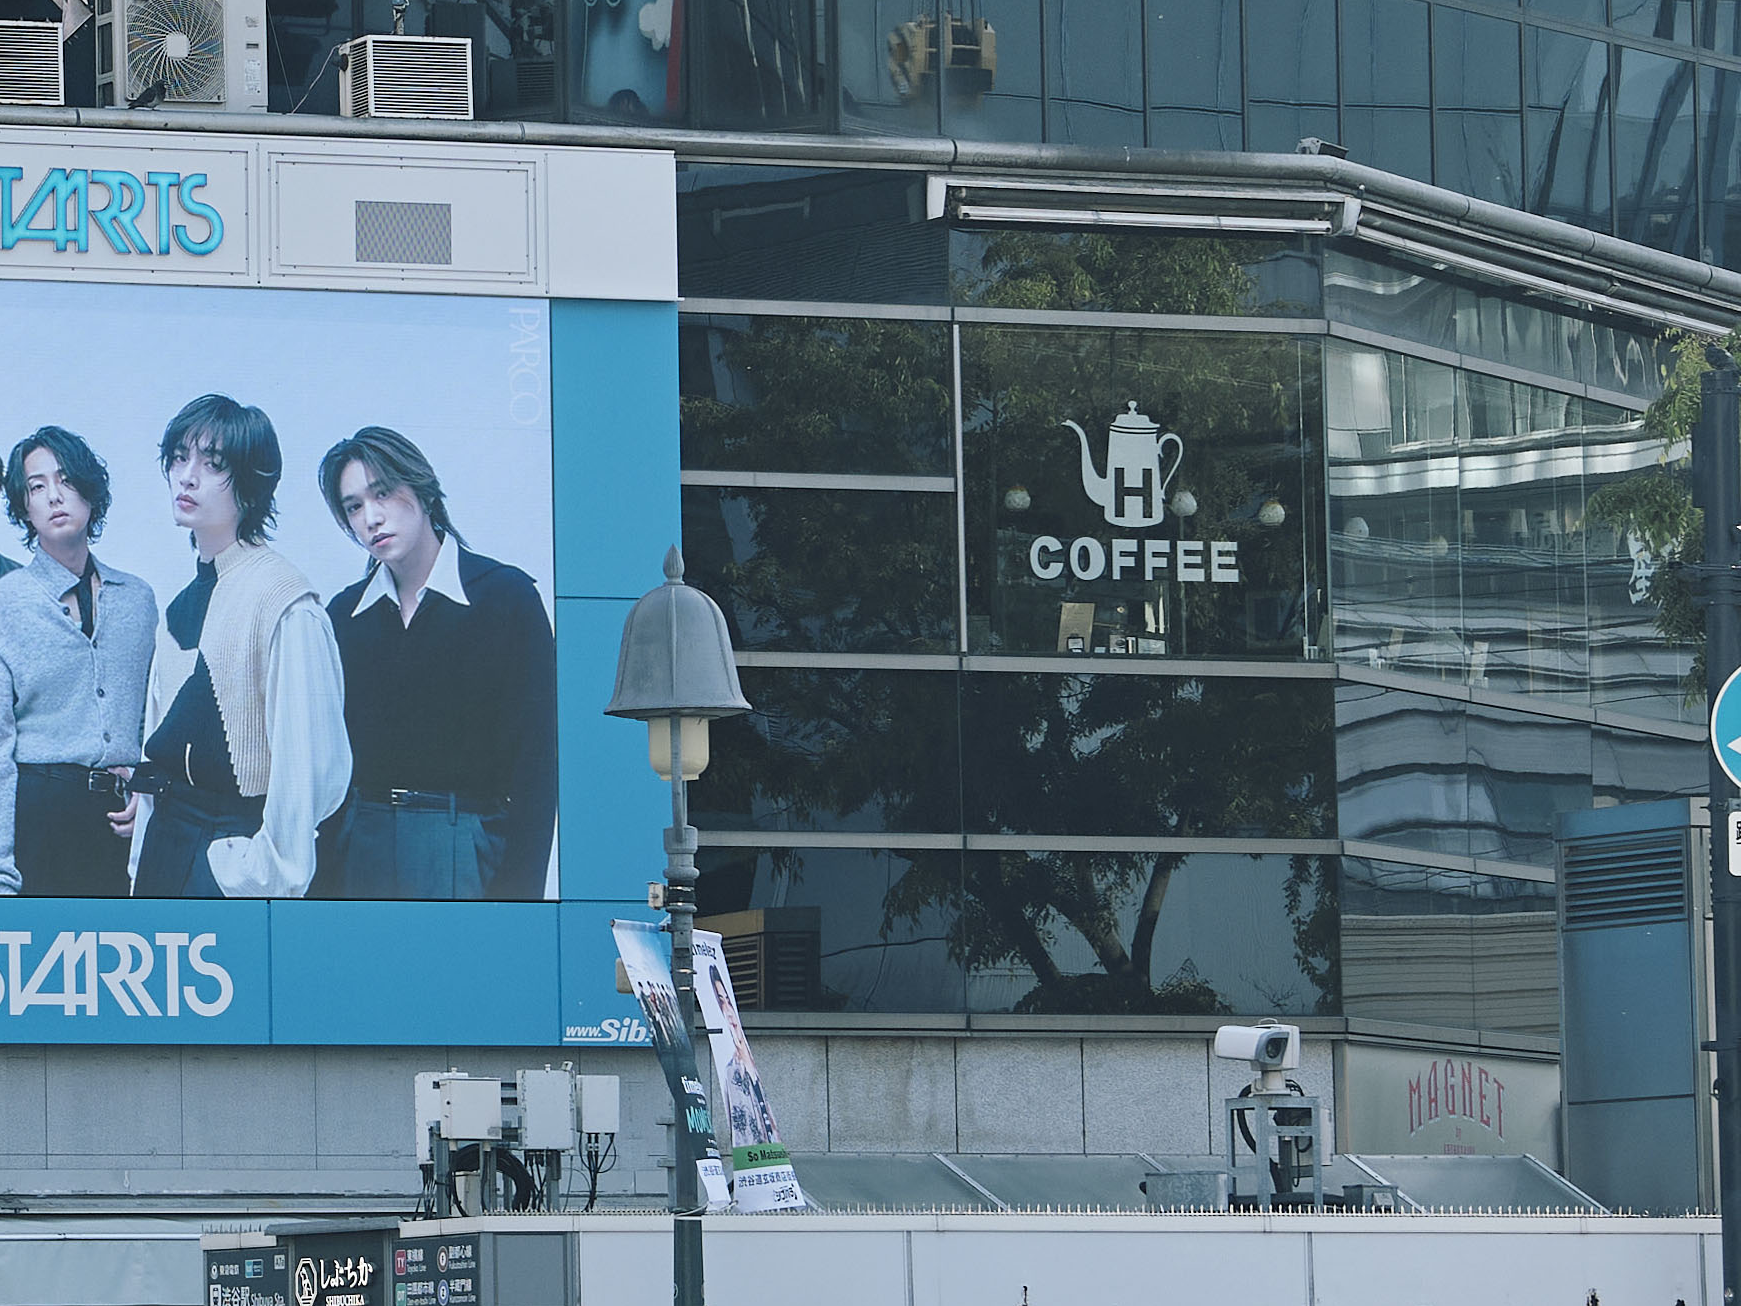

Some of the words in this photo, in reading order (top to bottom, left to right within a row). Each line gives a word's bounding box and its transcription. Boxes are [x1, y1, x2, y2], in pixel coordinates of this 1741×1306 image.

[1029, 535, 1239, 583] COFFEE
[319, 1255, 374, 1290] しぶちか
